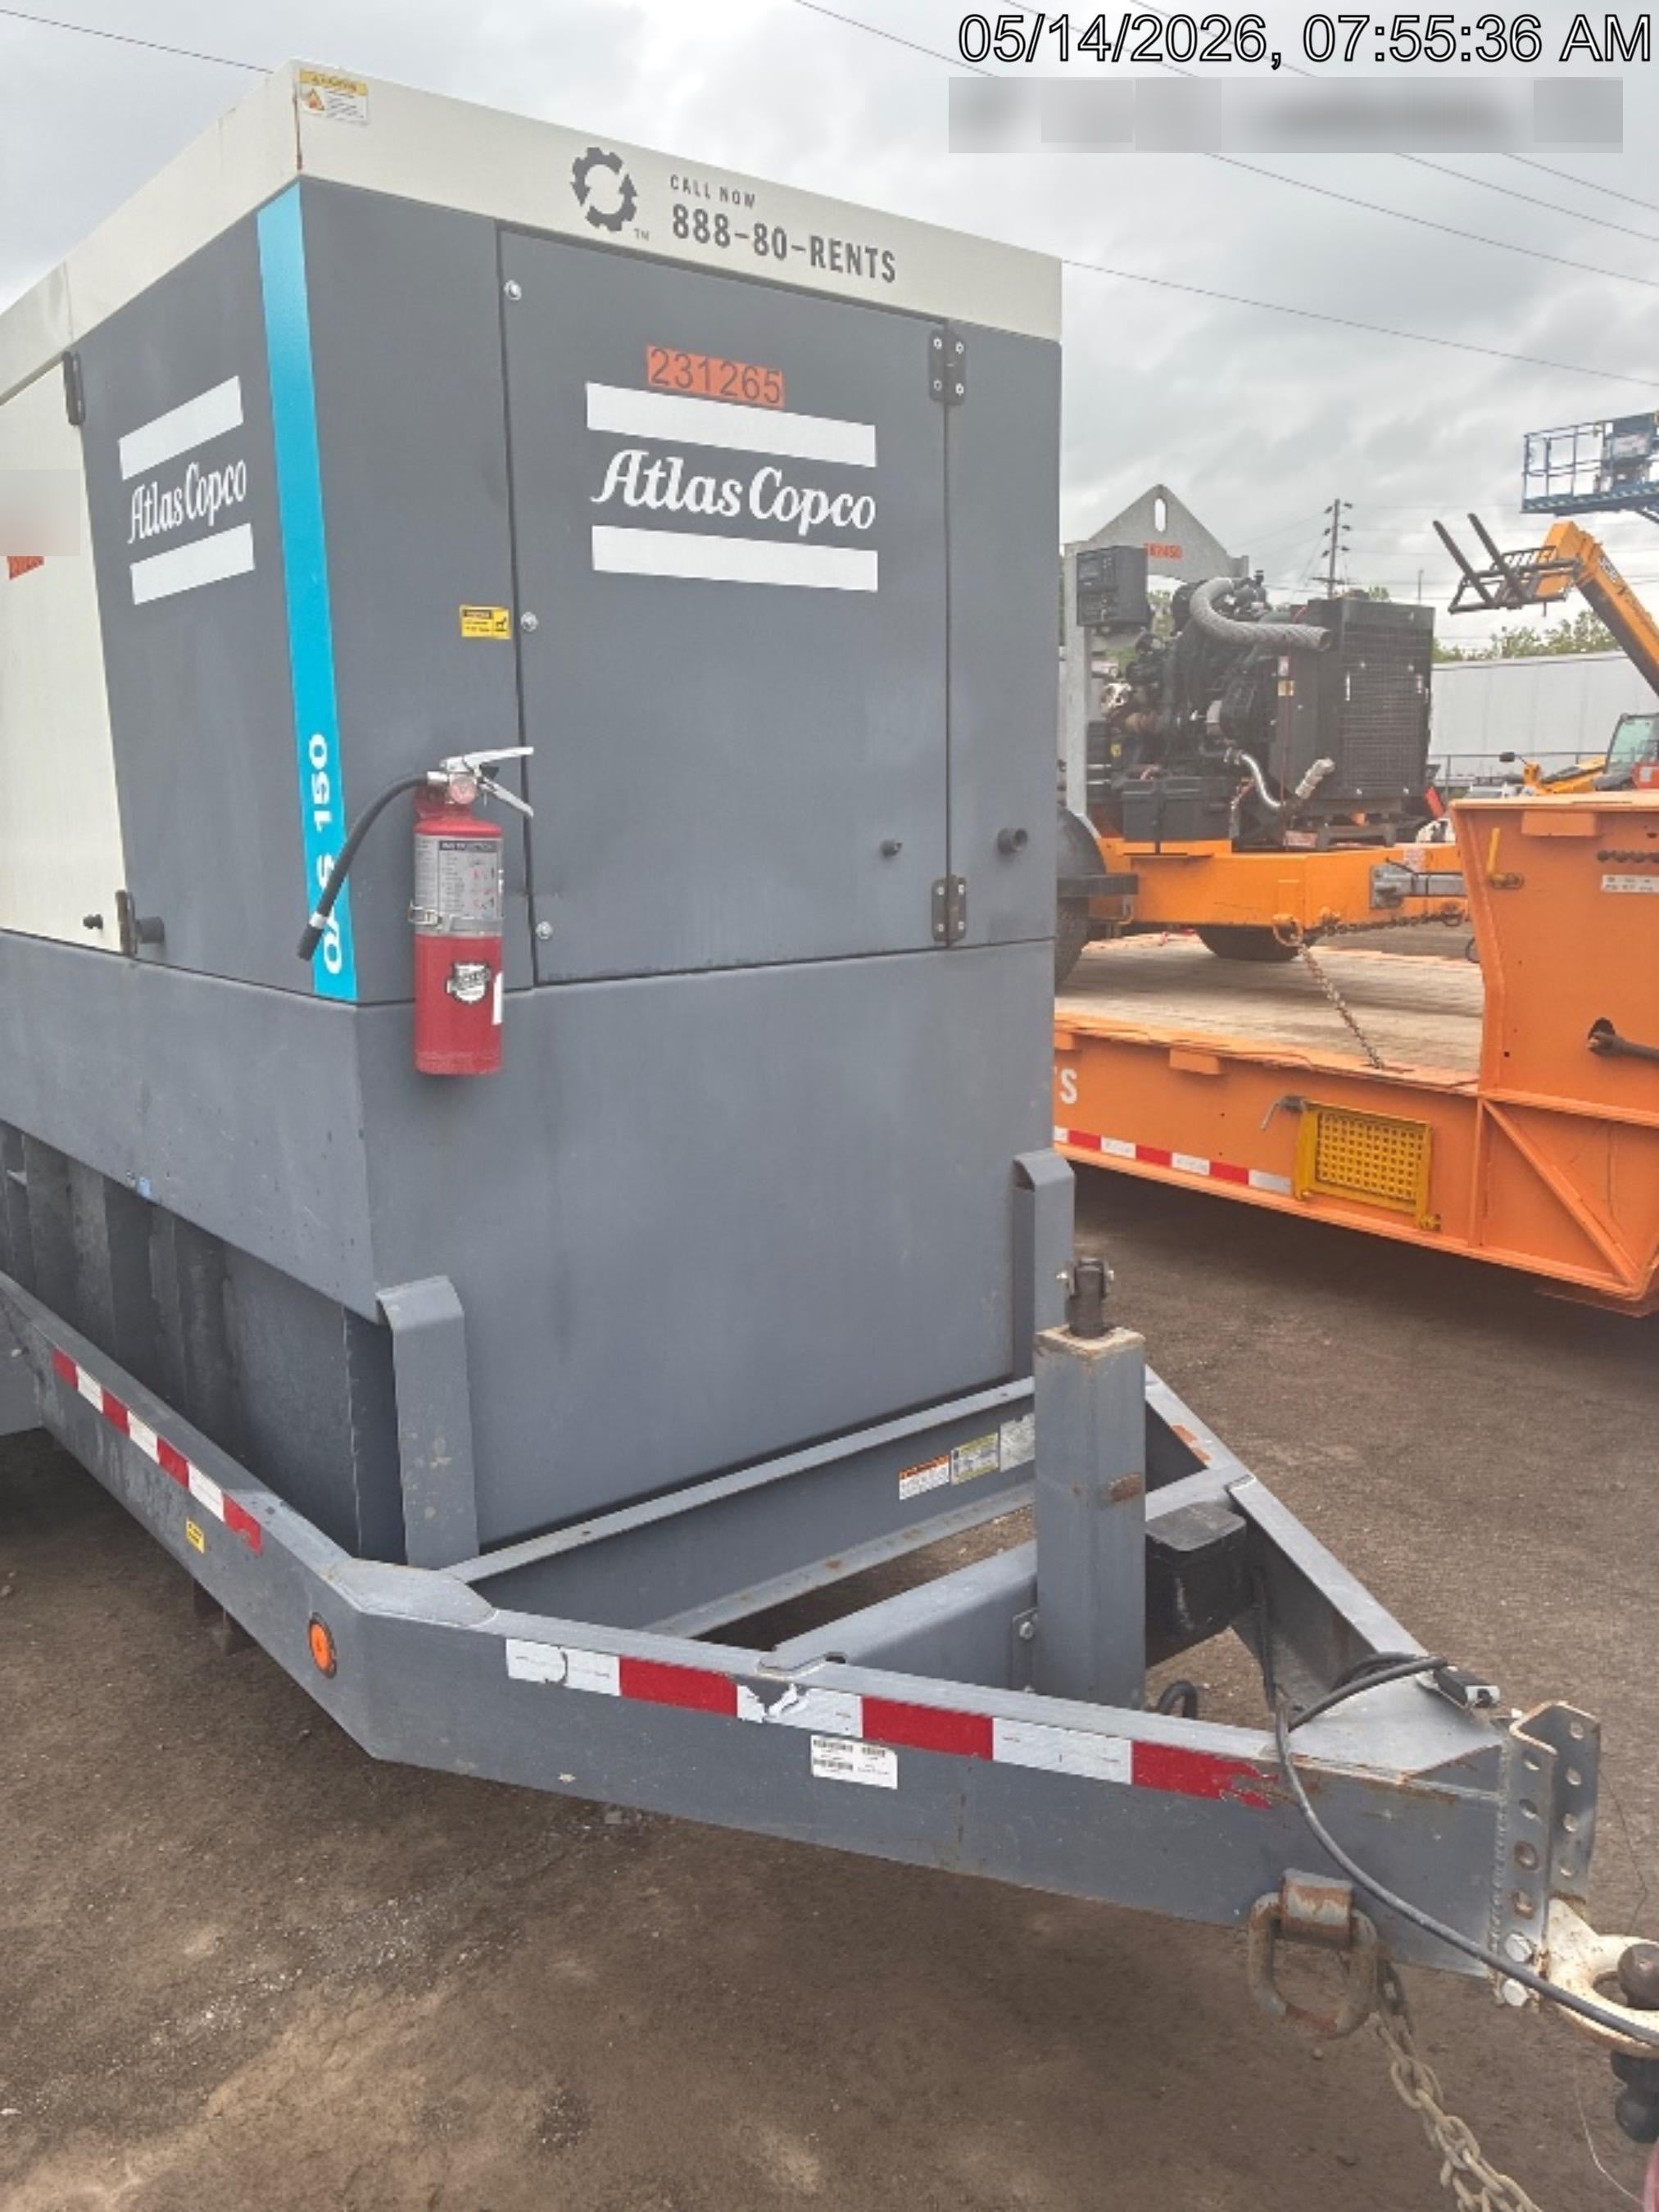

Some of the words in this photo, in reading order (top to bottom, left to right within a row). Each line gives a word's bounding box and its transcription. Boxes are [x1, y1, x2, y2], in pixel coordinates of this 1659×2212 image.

[670, 174, 711, 199] CALL
[719, 186, 755, 209] NOW
[672, 204, 895, 283] 888-80-RENTS
[650, 348, 782, 404] 231265
[127, 481, 184, 544] Atlas
[184, 459, 247, 527] Copco
[590, 449, 742, 517] Atlas
[749, 466, 876, 536] Copco
[309, 733, 332, 832] 150
